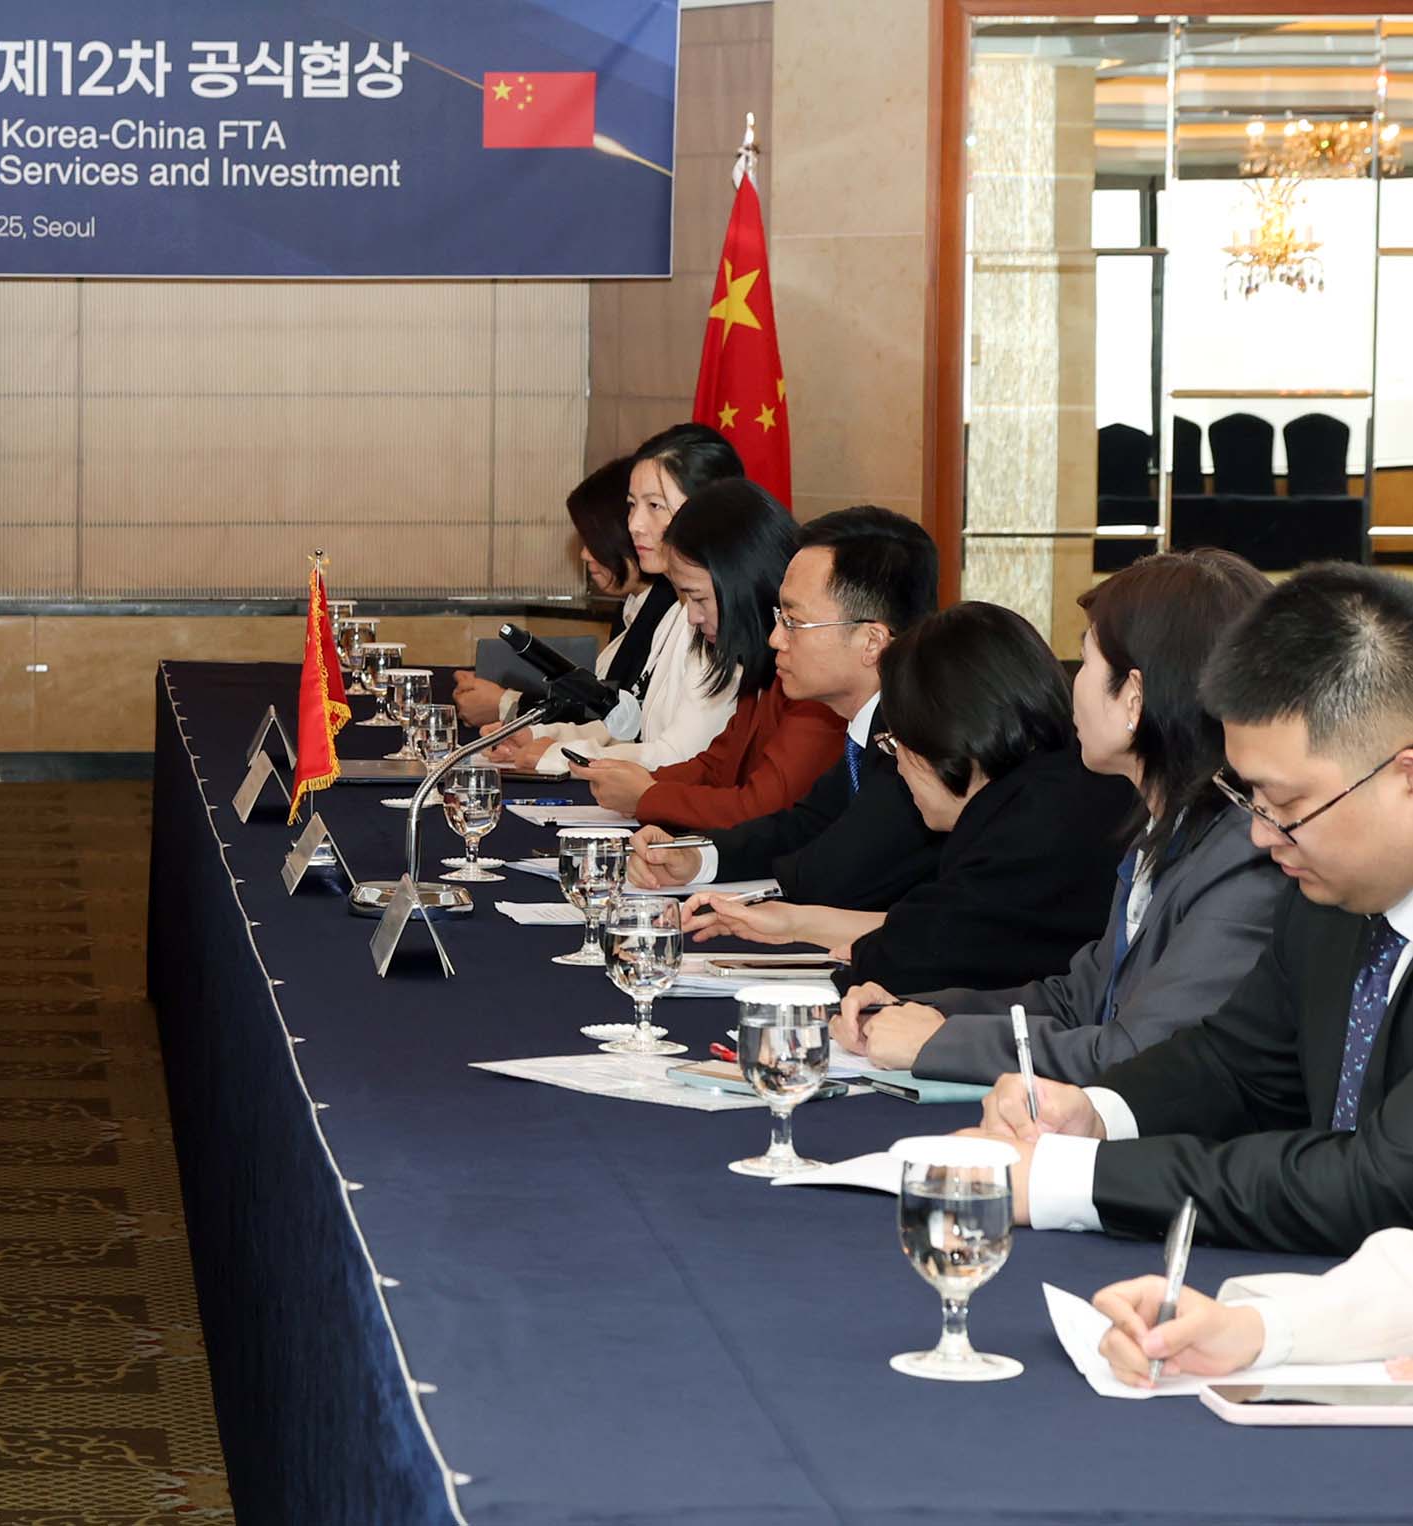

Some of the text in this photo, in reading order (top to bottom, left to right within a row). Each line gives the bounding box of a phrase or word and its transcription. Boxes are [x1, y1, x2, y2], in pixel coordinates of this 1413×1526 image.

[187, 39, 410, 99] 공식협상
[1, 118, 207, 150] Korea-China
[218, 120, 287, 150] FTA
[149, 156, 210, 187] and
[222, 156, 401, 187] Investment
[32, 215, 95, 238] Seoul
